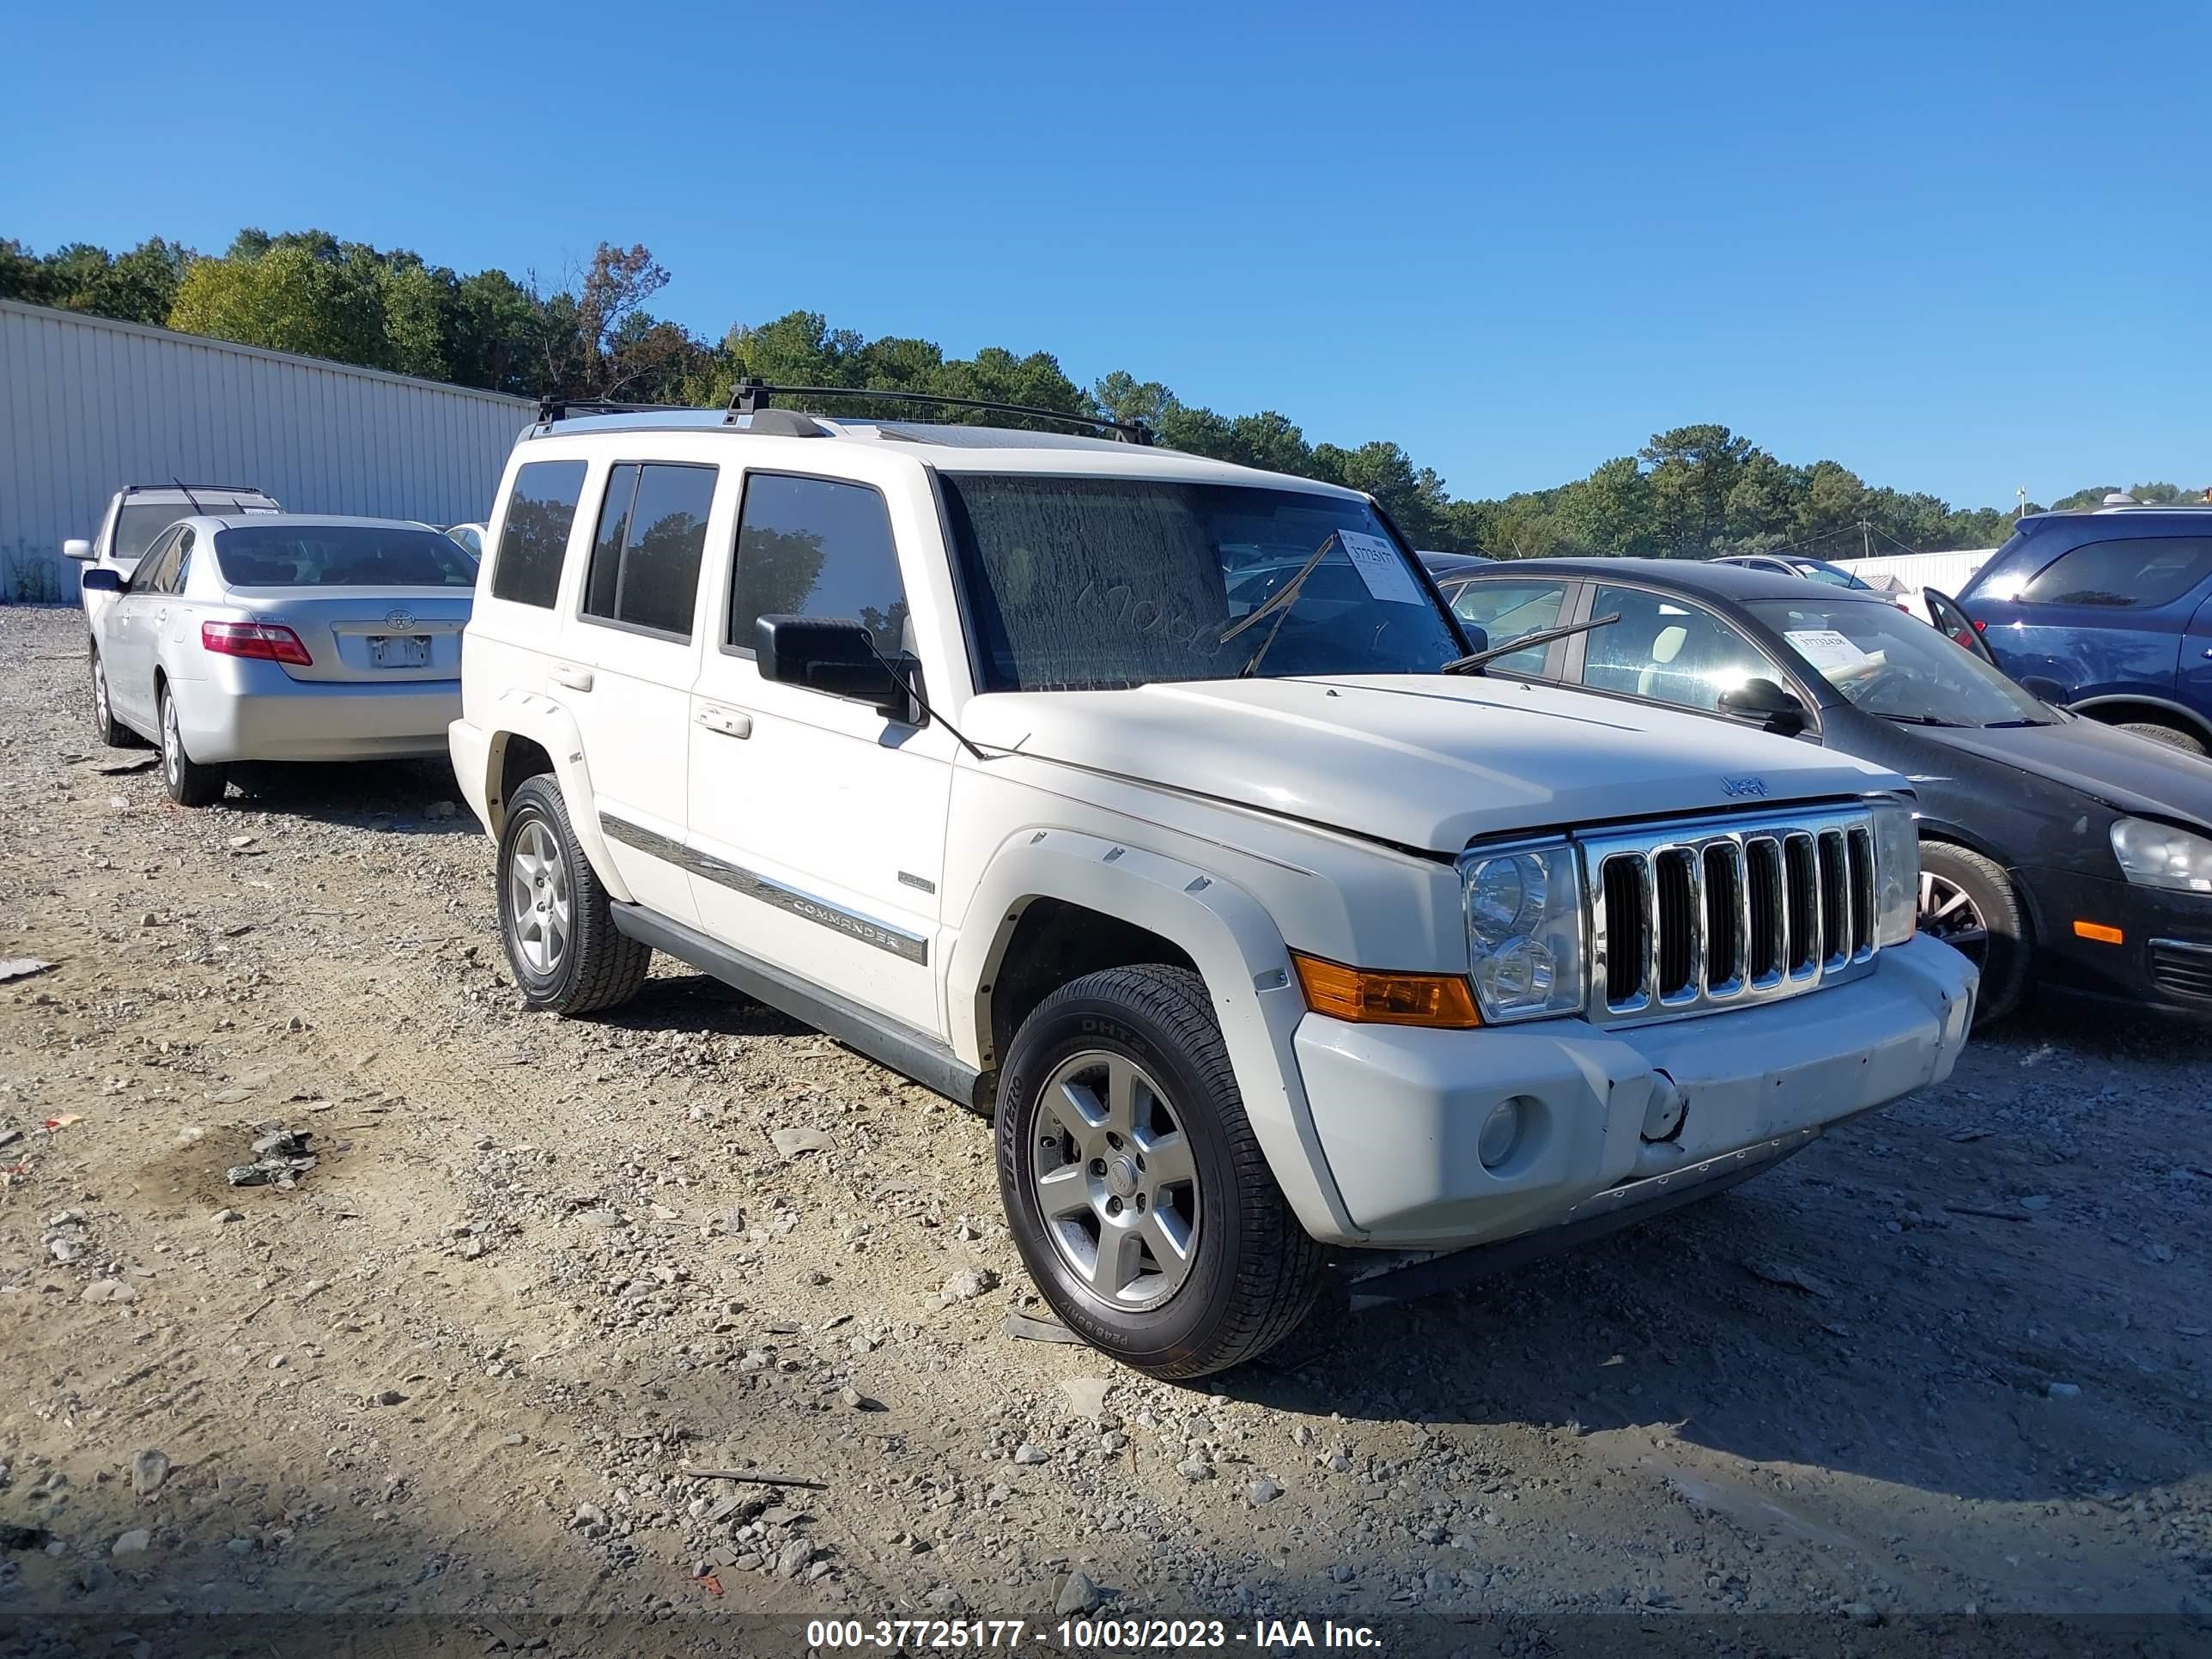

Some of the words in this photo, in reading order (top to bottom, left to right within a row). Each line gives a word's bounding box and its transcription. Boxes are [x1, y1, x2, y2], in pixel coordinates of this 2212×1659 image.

[1351, 545, 1395, 565] 37725177
[1718, 776, 1769, 797] Jeep
[793, 899, 900, 949] COMMANDER
